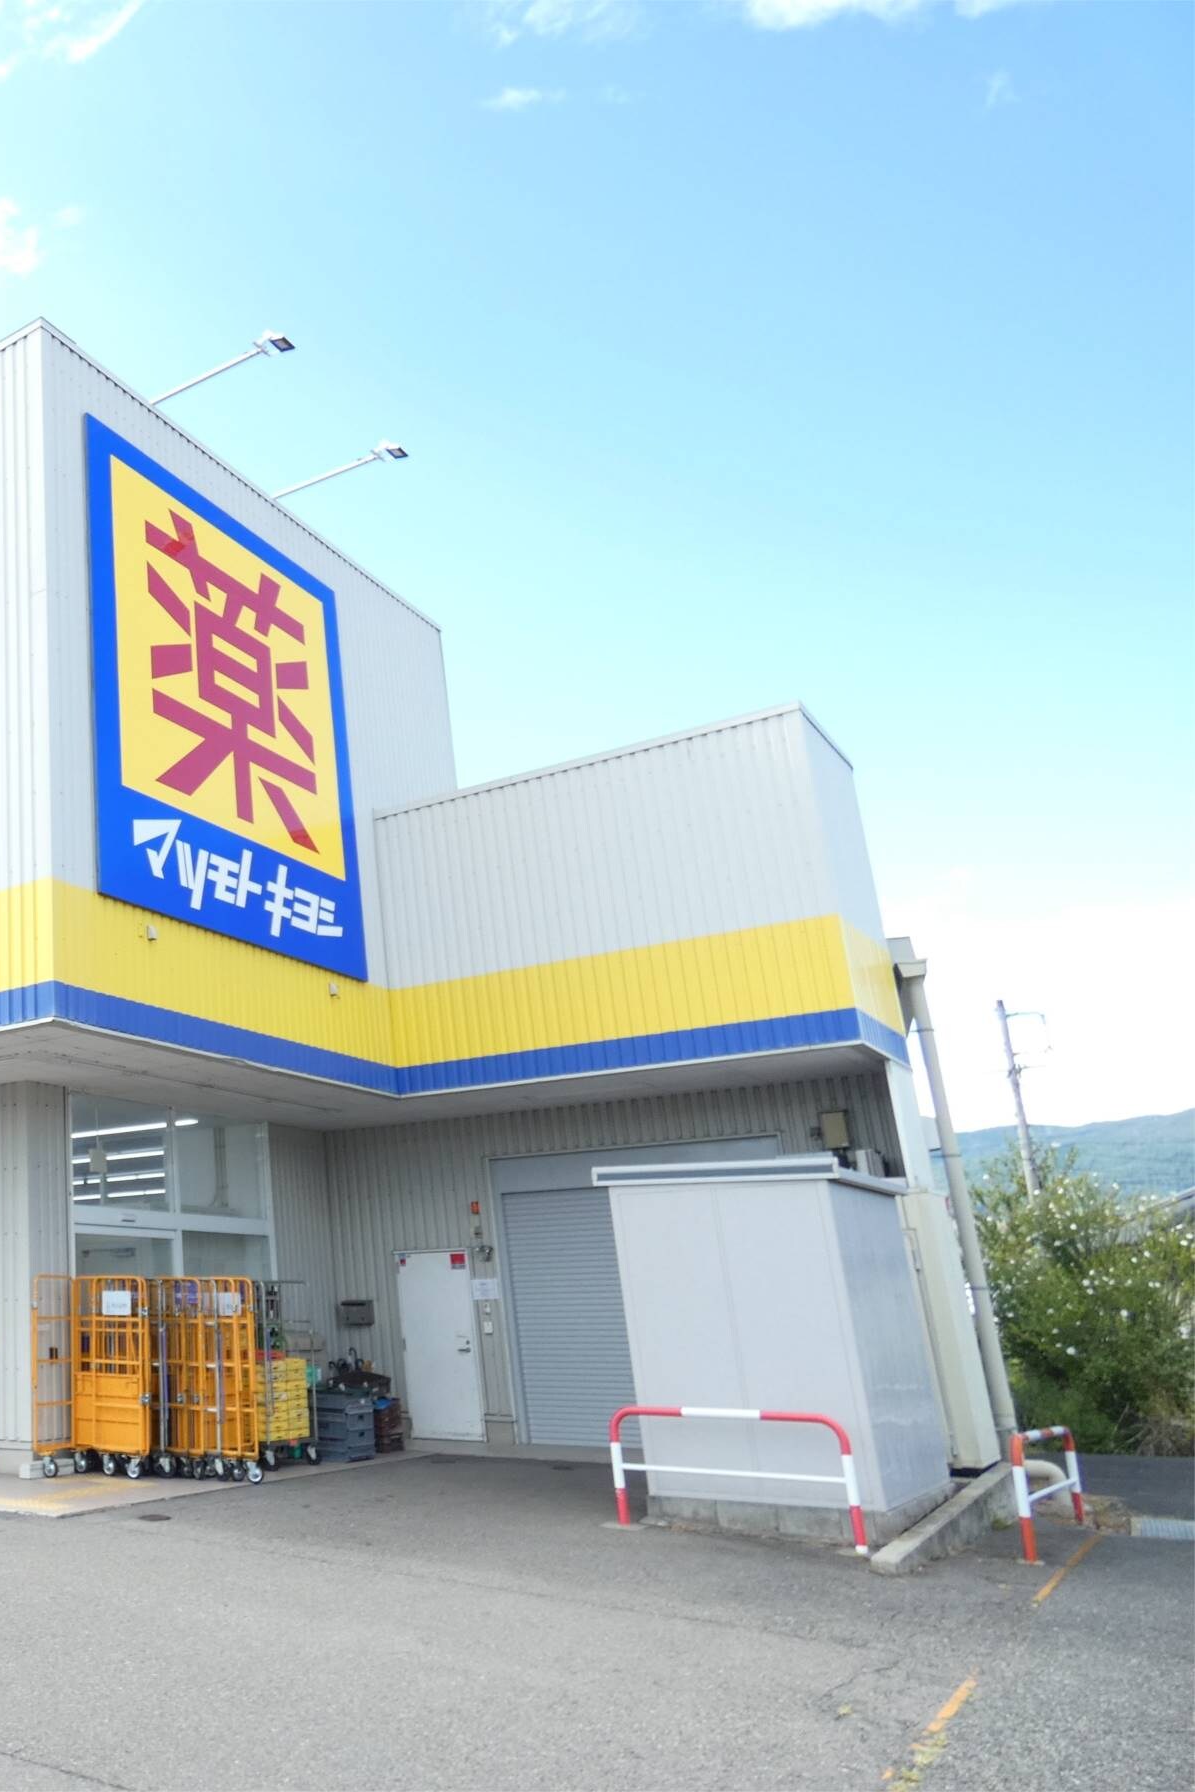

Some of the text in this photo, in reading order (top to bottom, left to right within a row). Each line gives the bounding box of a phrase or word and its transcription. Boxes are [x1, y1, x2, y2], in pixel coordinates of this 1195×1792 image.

[144, 508, 320, 854] 薬
[132, 818, 343, 937] マツモトキヨシ
